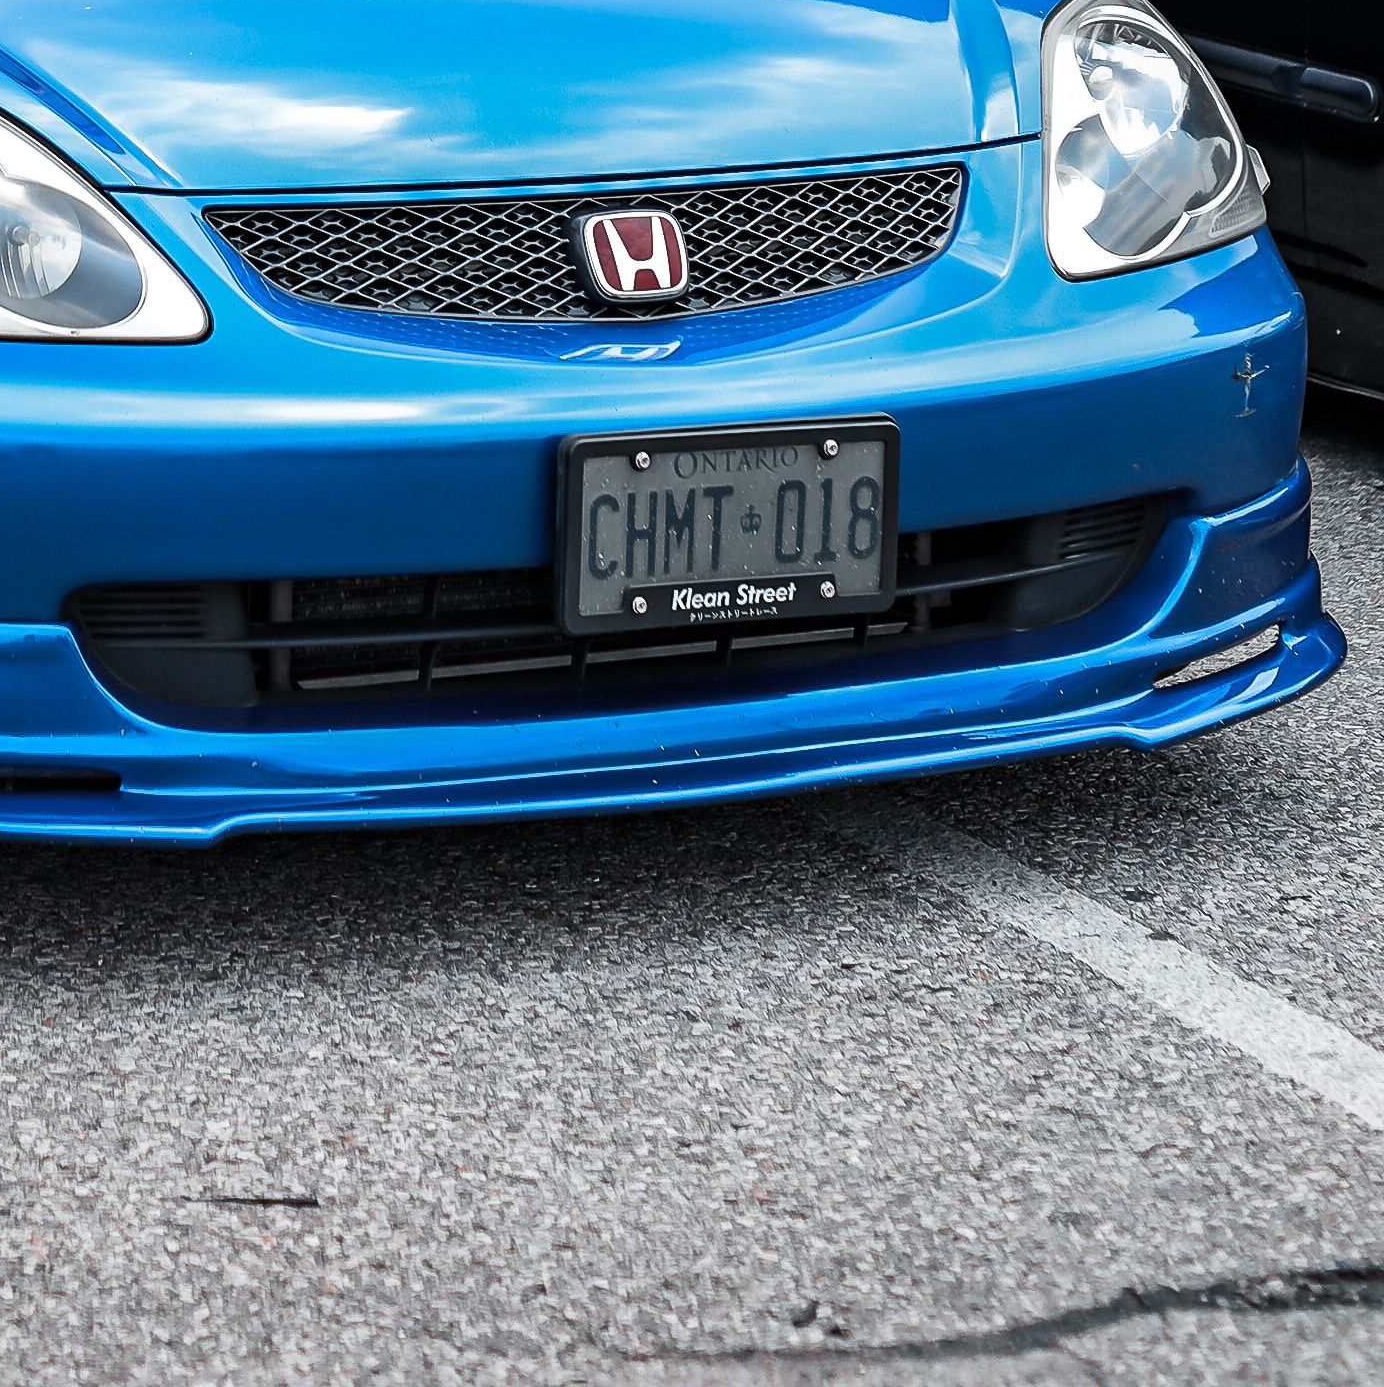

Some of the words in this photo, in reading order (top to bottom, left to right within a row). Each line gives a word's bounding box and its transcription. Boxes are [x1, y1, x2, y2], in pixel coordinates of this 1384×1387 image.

[674, 443, 800, 480] ONTARIO
[587, 484, 734, 581] CHMT
[773, 474, 881, 565] 018
[672, 587, 731, 611] Klean
[736, 582, 797, 606] Street
